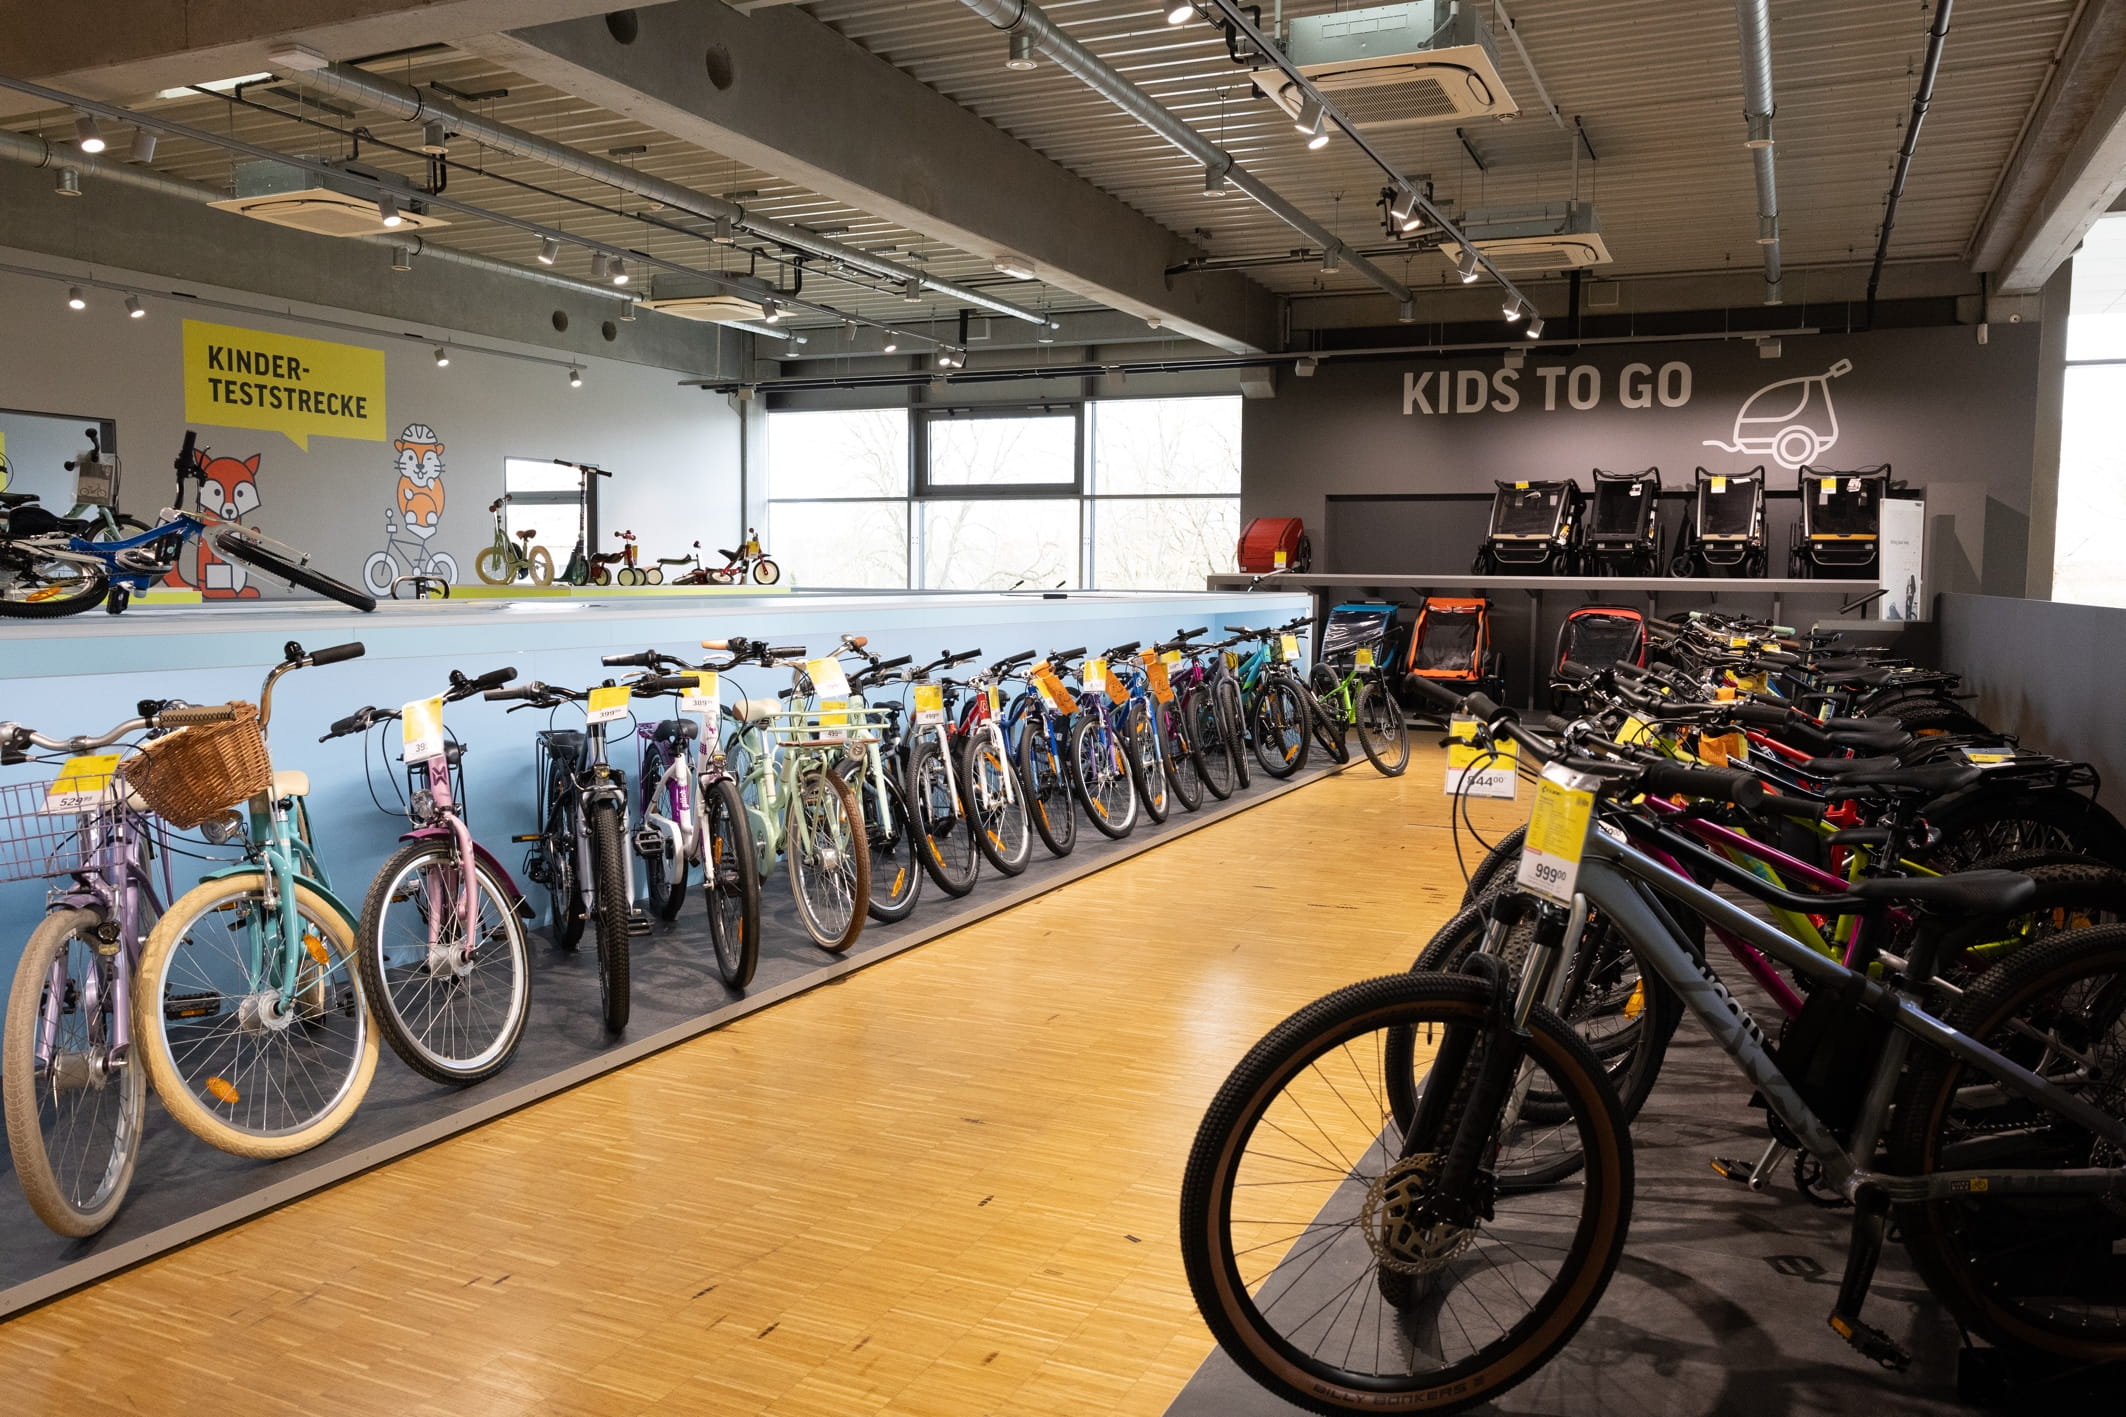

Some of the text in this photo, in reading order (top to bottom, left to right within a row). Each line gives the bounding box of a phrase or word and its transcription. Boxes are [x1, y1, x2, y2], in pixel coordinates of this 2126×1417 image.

[208, 344, 310, 381] KINDER-
[208, 377, 368, 419] TESTSTRECKE
[1402, 361, 1693, 415] KIDS TO GO
[1312, 1382, 1467, 1406] BILLY BONKERS
